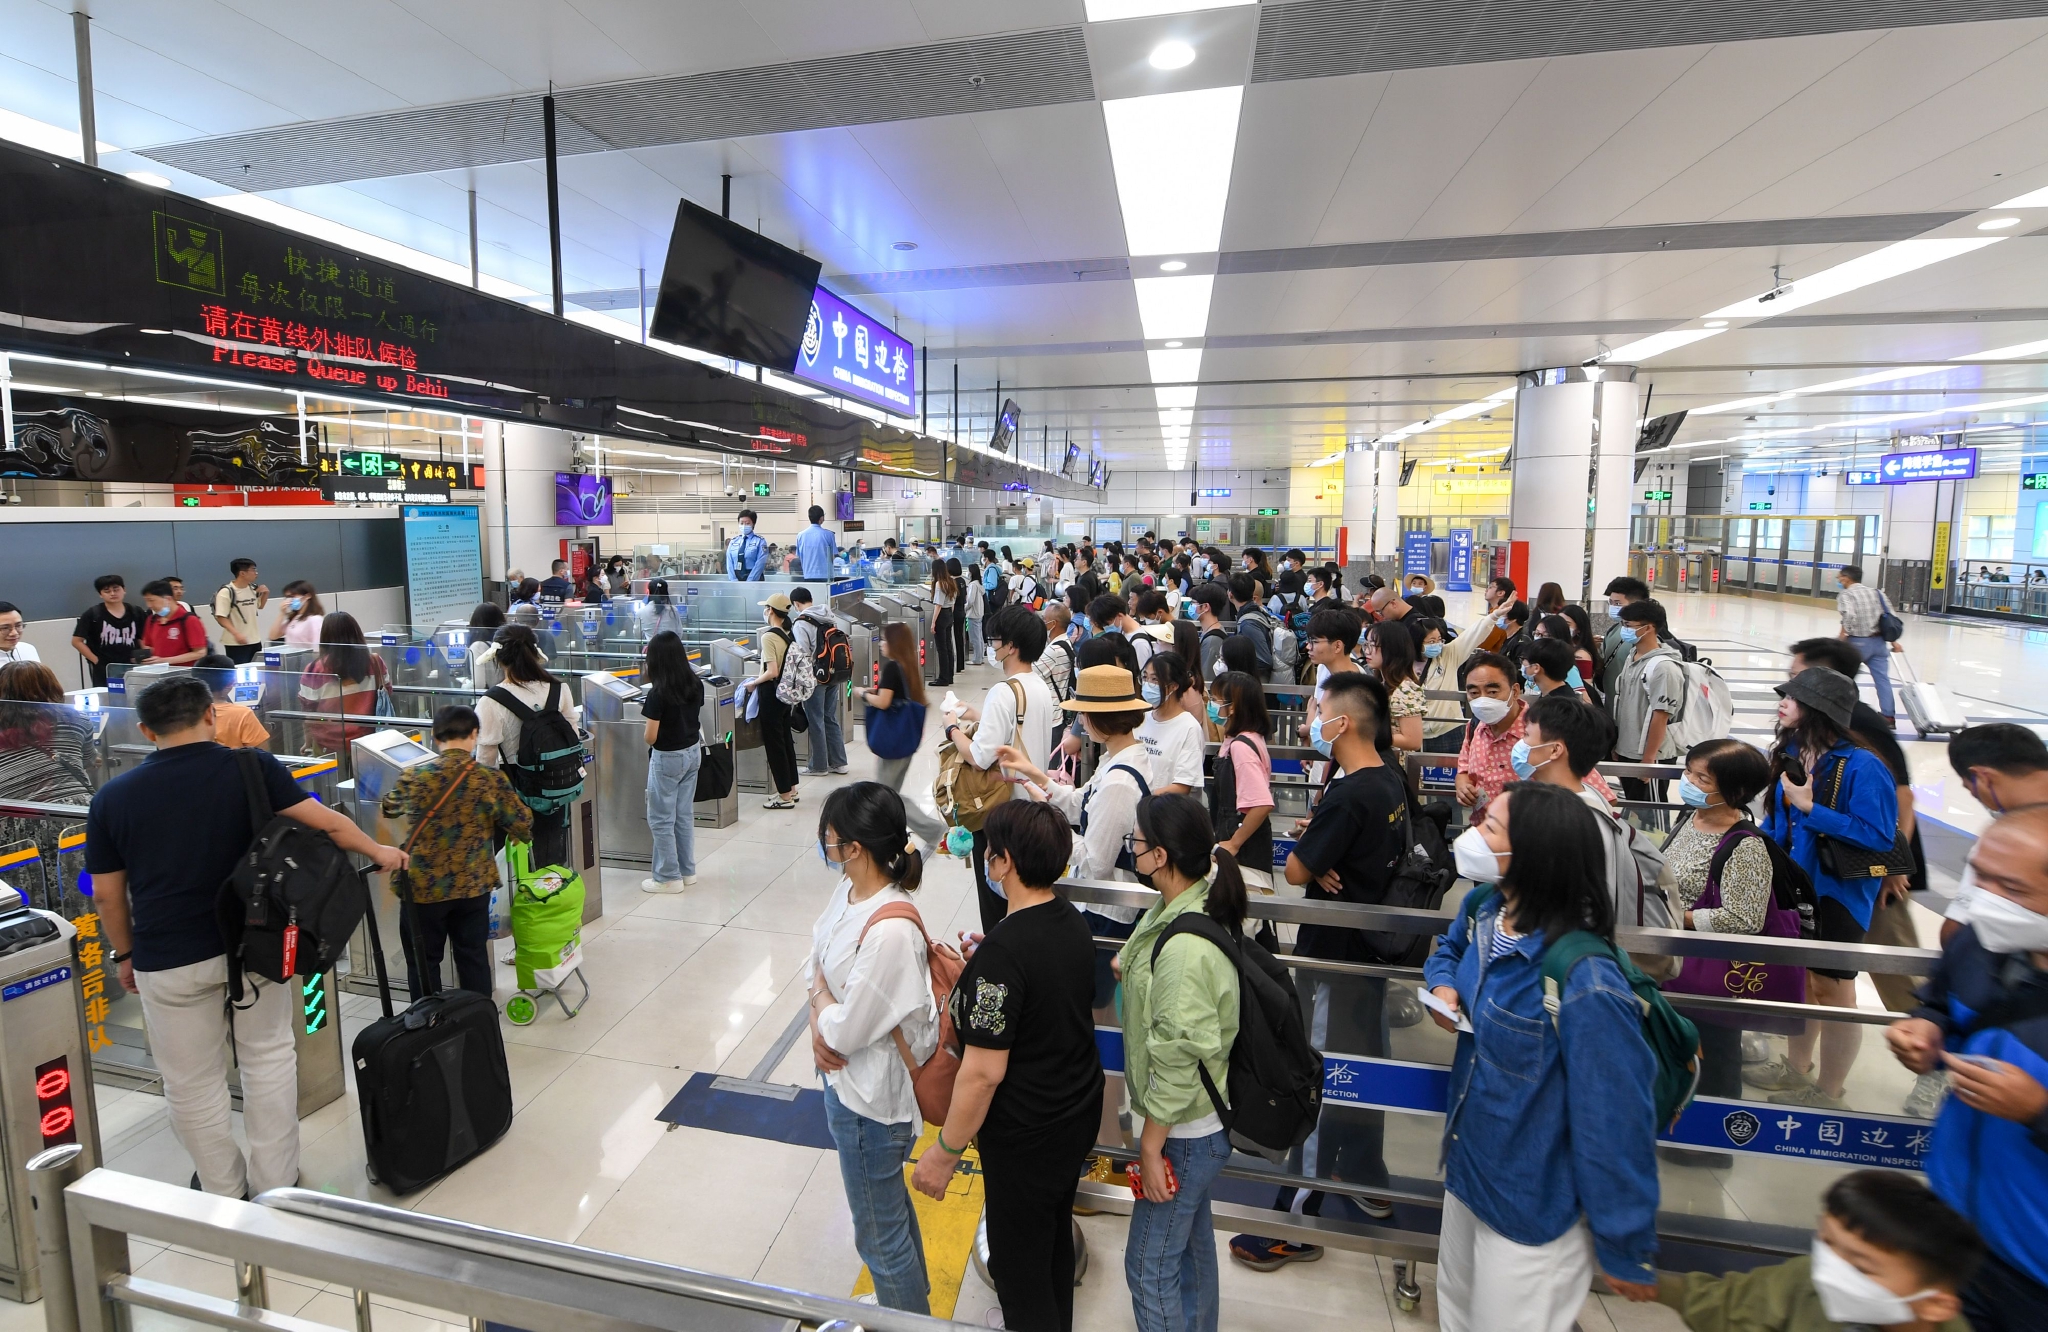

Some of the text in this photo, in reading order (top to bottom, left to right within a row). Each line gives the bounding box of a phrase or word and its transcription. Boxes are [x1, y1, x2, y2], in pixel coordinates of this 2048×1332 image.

[284, 246, 398, 305] 快捷通道
[236, 271, 439, 343] 每次仅限一人通行
[199, 304, 418, 370] 请在黄线外排队候检
[832, 311, 909, 385] 中国边检
[213, 339, 297, 374] Please
[306, 357, 367, 385] Queue
[376, 375, 399, 393] up
[832, 365, 852, 384] CHINA
[1272, 843, 1288, 857] 检
[25, 974, 58, 990] 请放证件
[1326, 1062, 1360, 1086] 检
[1322, 1088, 1359, 1098] PECTION
[1774, 1144, 1806, 1155] CHINA
[1809, 1148, 1877, 1162] IMMIGRATION
